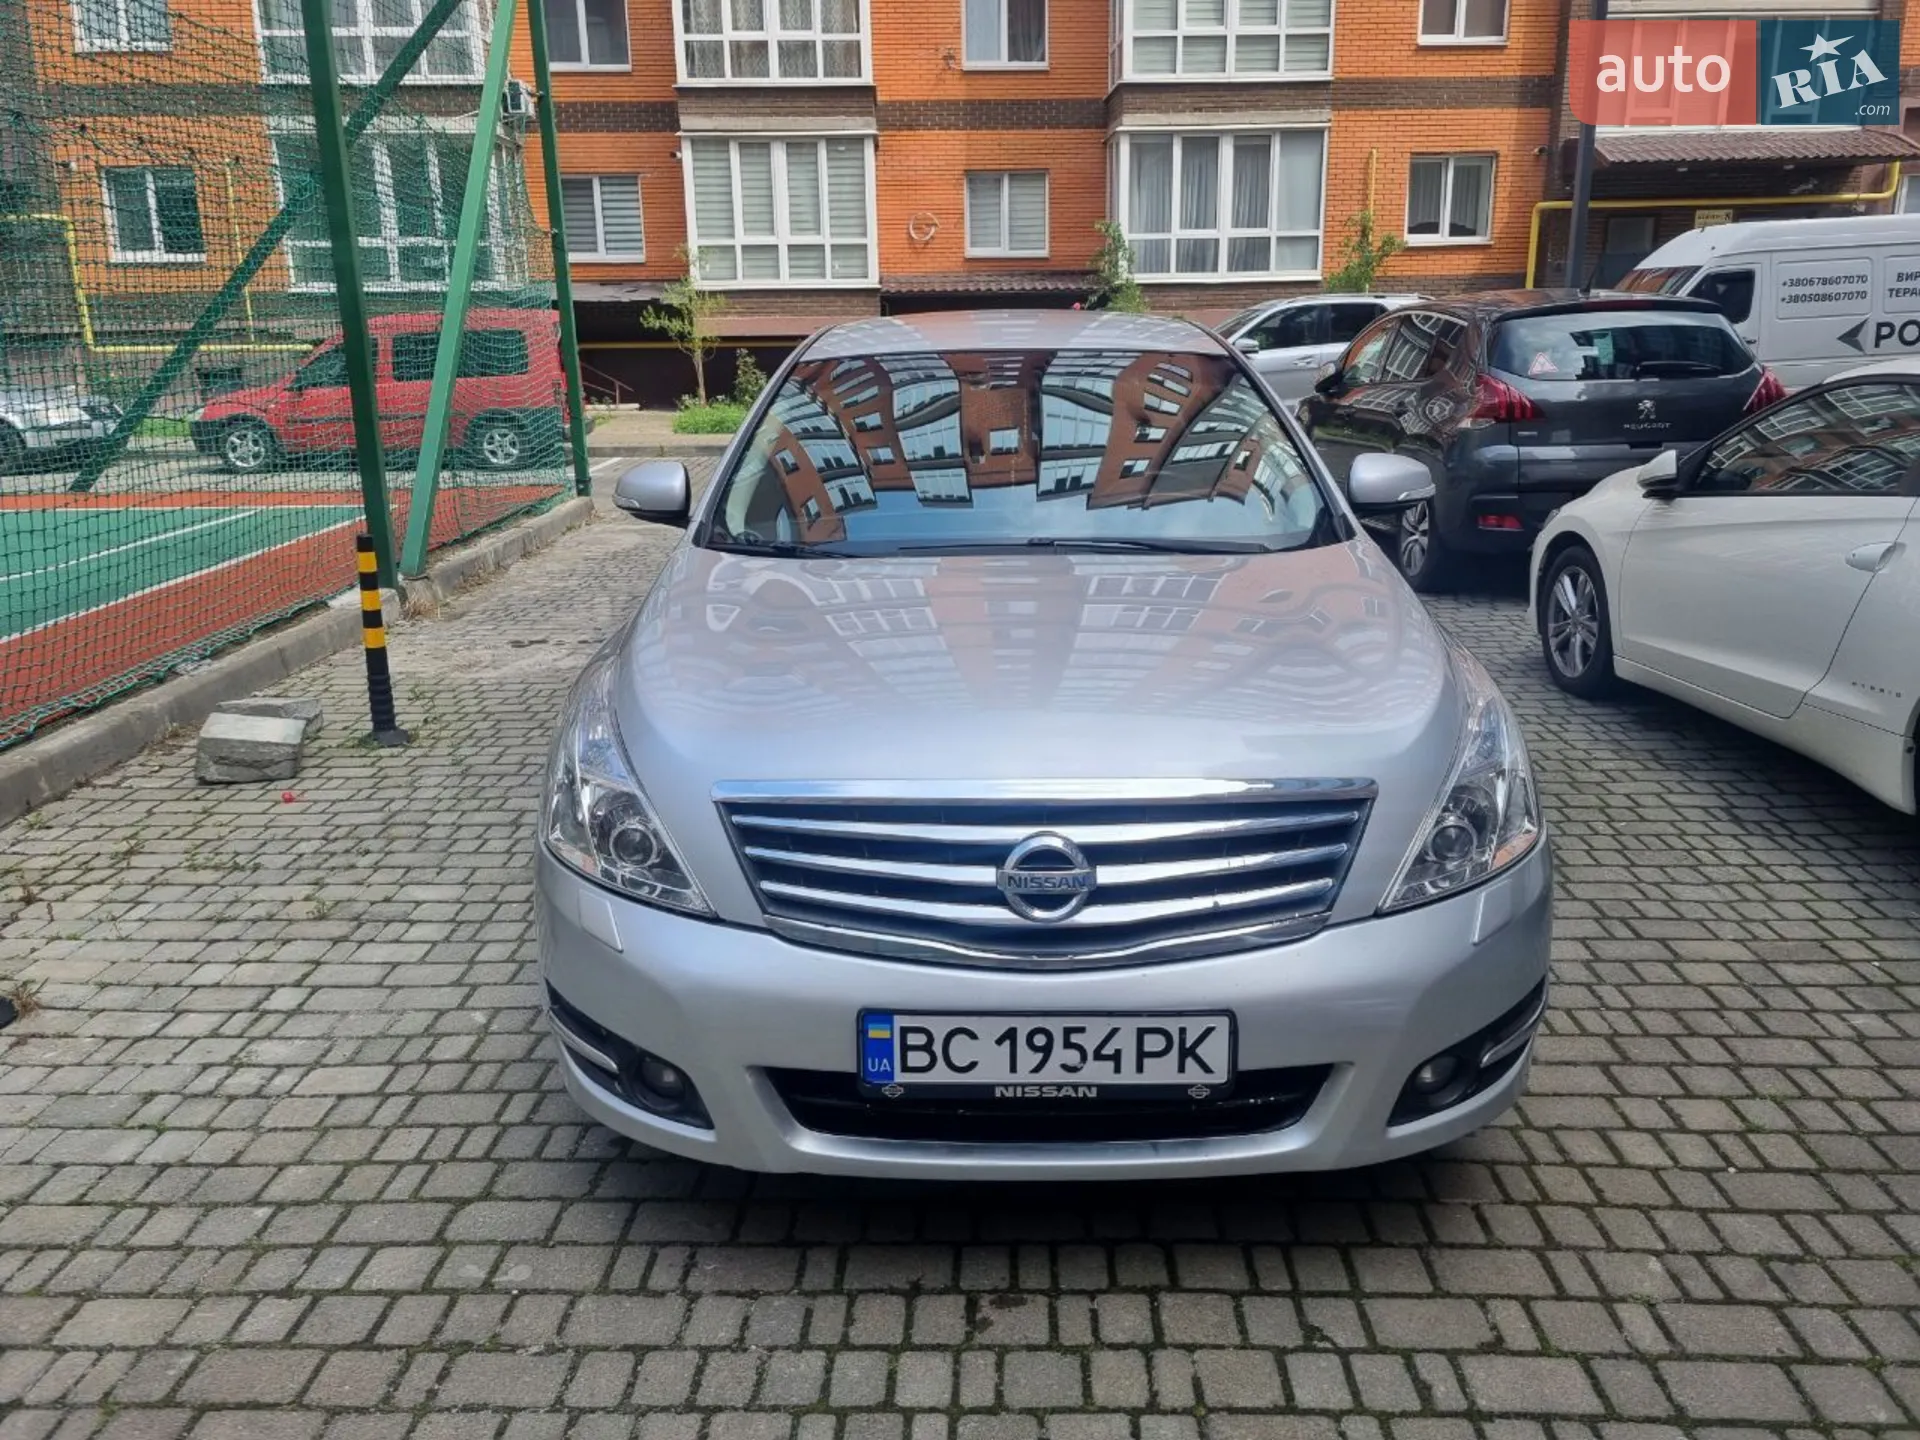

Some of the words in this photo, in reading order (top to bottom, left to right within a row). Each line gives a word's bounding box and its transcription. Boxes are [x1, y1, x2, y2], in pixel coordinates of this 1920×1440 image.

[1782, 274, 1868, 287] +380678607070
[1780, 290, 1867, 303] +380508607070
[1887, 287, 1920, 298] ТЕРА
[1007, 876, 1086, 889] NISSAN
[868, 1057, 891, 1073] UA
[994, 1085, 1098, 1098] NISSAN
